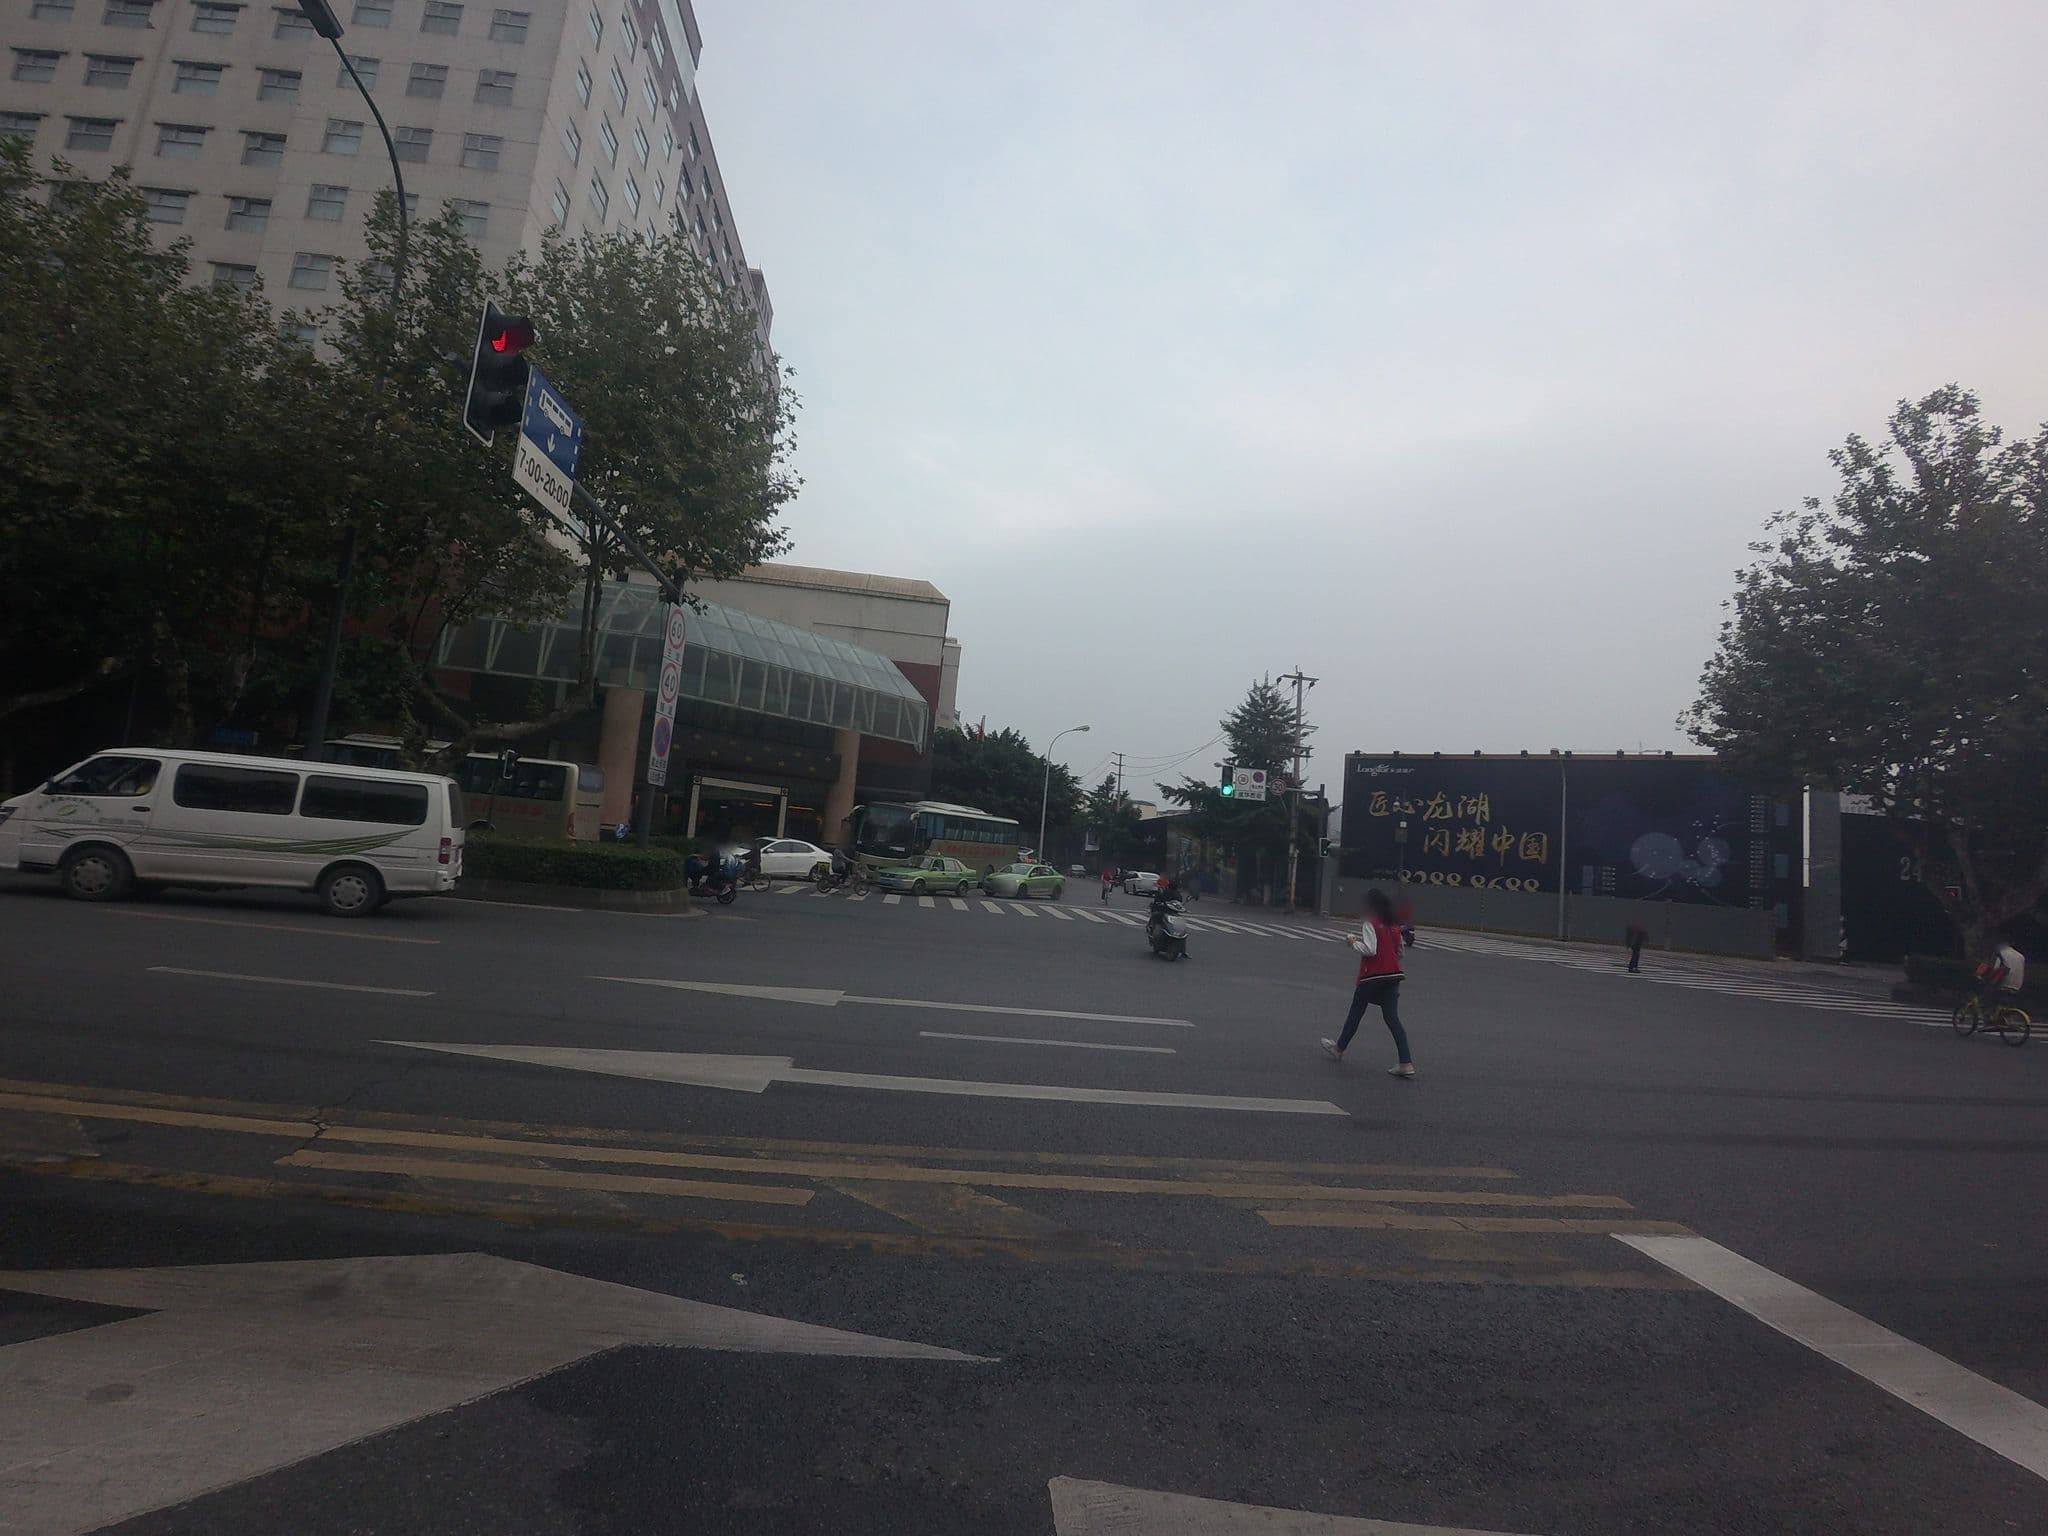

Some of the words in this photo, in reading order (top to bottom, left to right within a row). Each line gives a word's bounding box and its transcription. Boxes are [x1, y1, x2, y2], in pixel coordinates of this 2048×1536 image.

[520, 447, 569, 508] 7:00-20:00
[672, 621, 682, 639] 60
[665, 674, 676, 691] 40
[1369, 791, 1490, 825] 匠心龙湖
[1424, 826, 1548, 866] 闪耀中国
